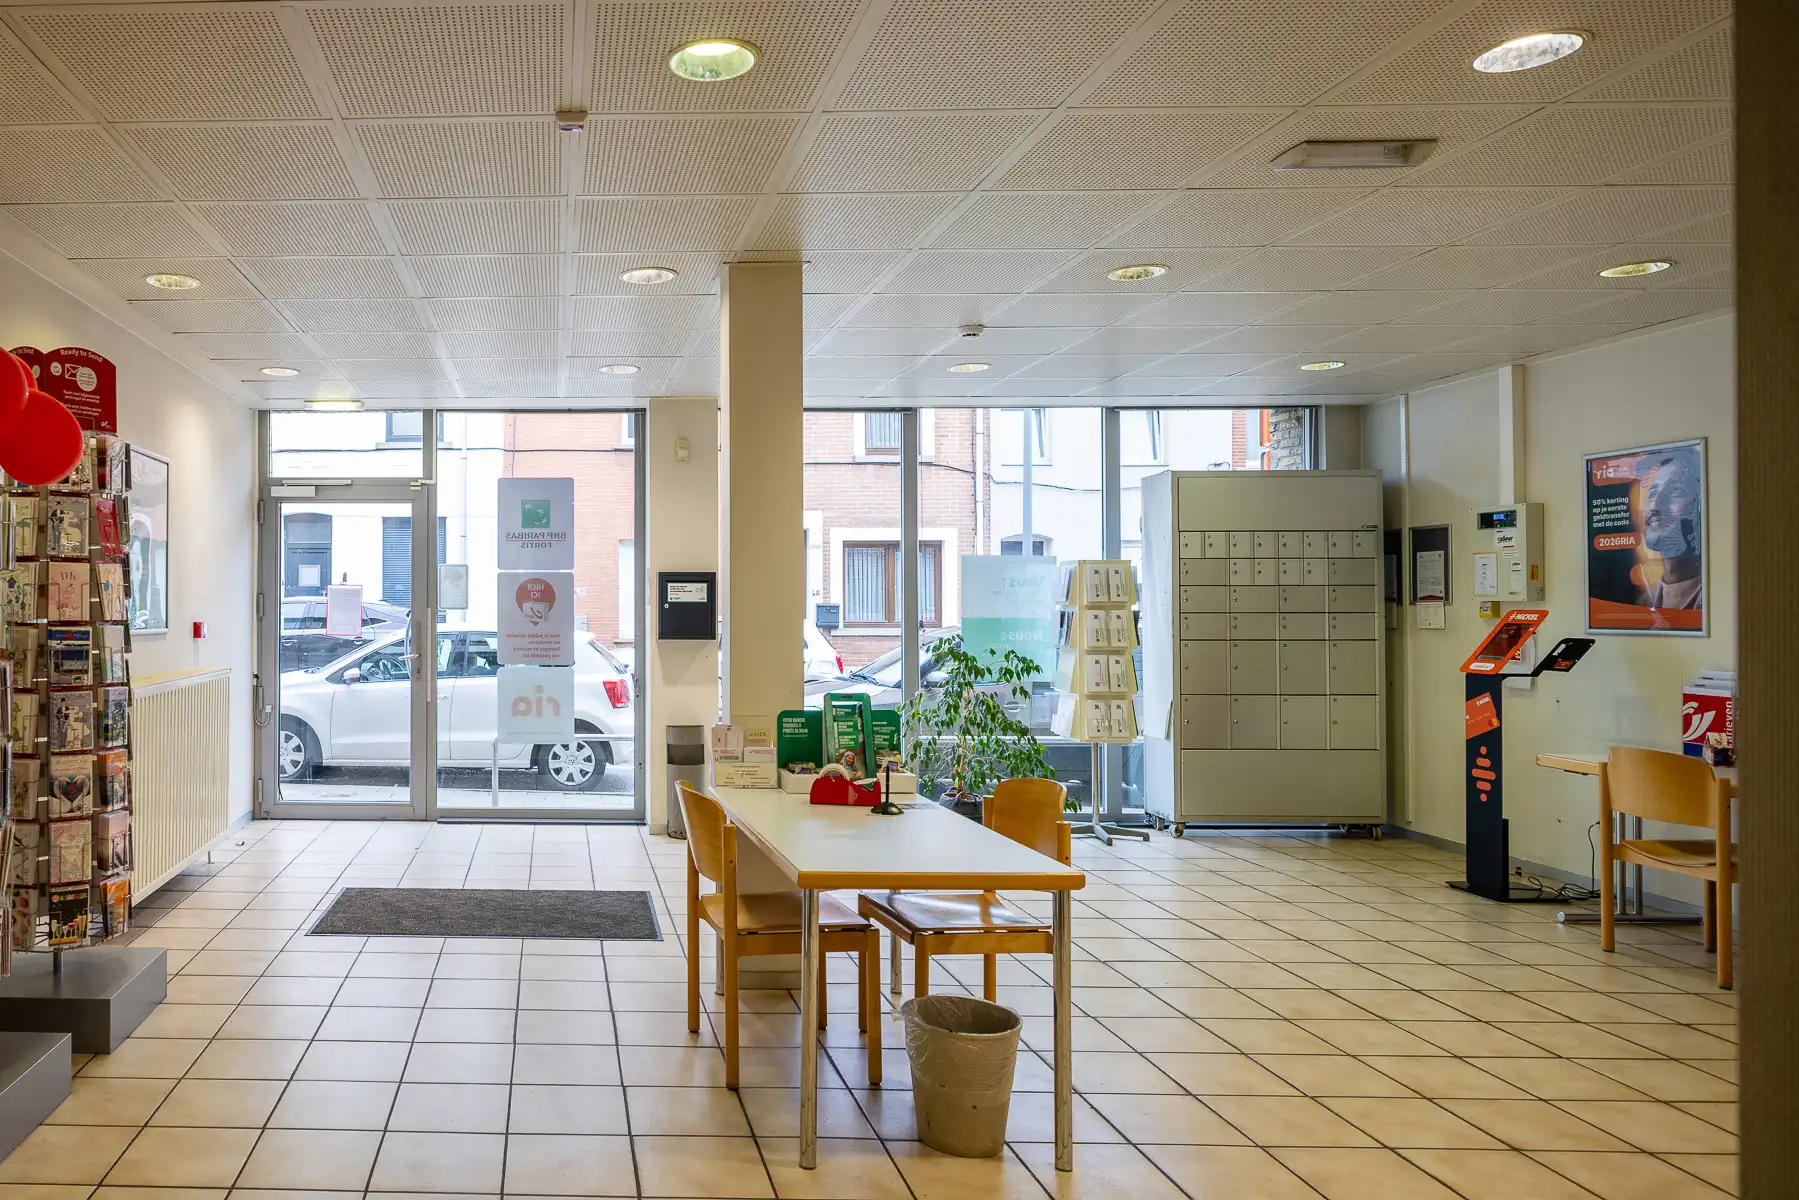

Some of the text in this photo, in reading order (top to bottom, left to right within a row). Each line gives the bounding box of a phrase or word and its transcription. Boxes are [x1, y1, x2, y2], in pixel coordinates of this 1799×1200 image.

[60, 349, 79, 357] Ready
[88, 352, 103, 363] Send
[1608, 504, 1627, 512] eerste
[1593, 512, 1630, 521] geldtransfer
[1599, 536, 1636, 547] 2026RIA
